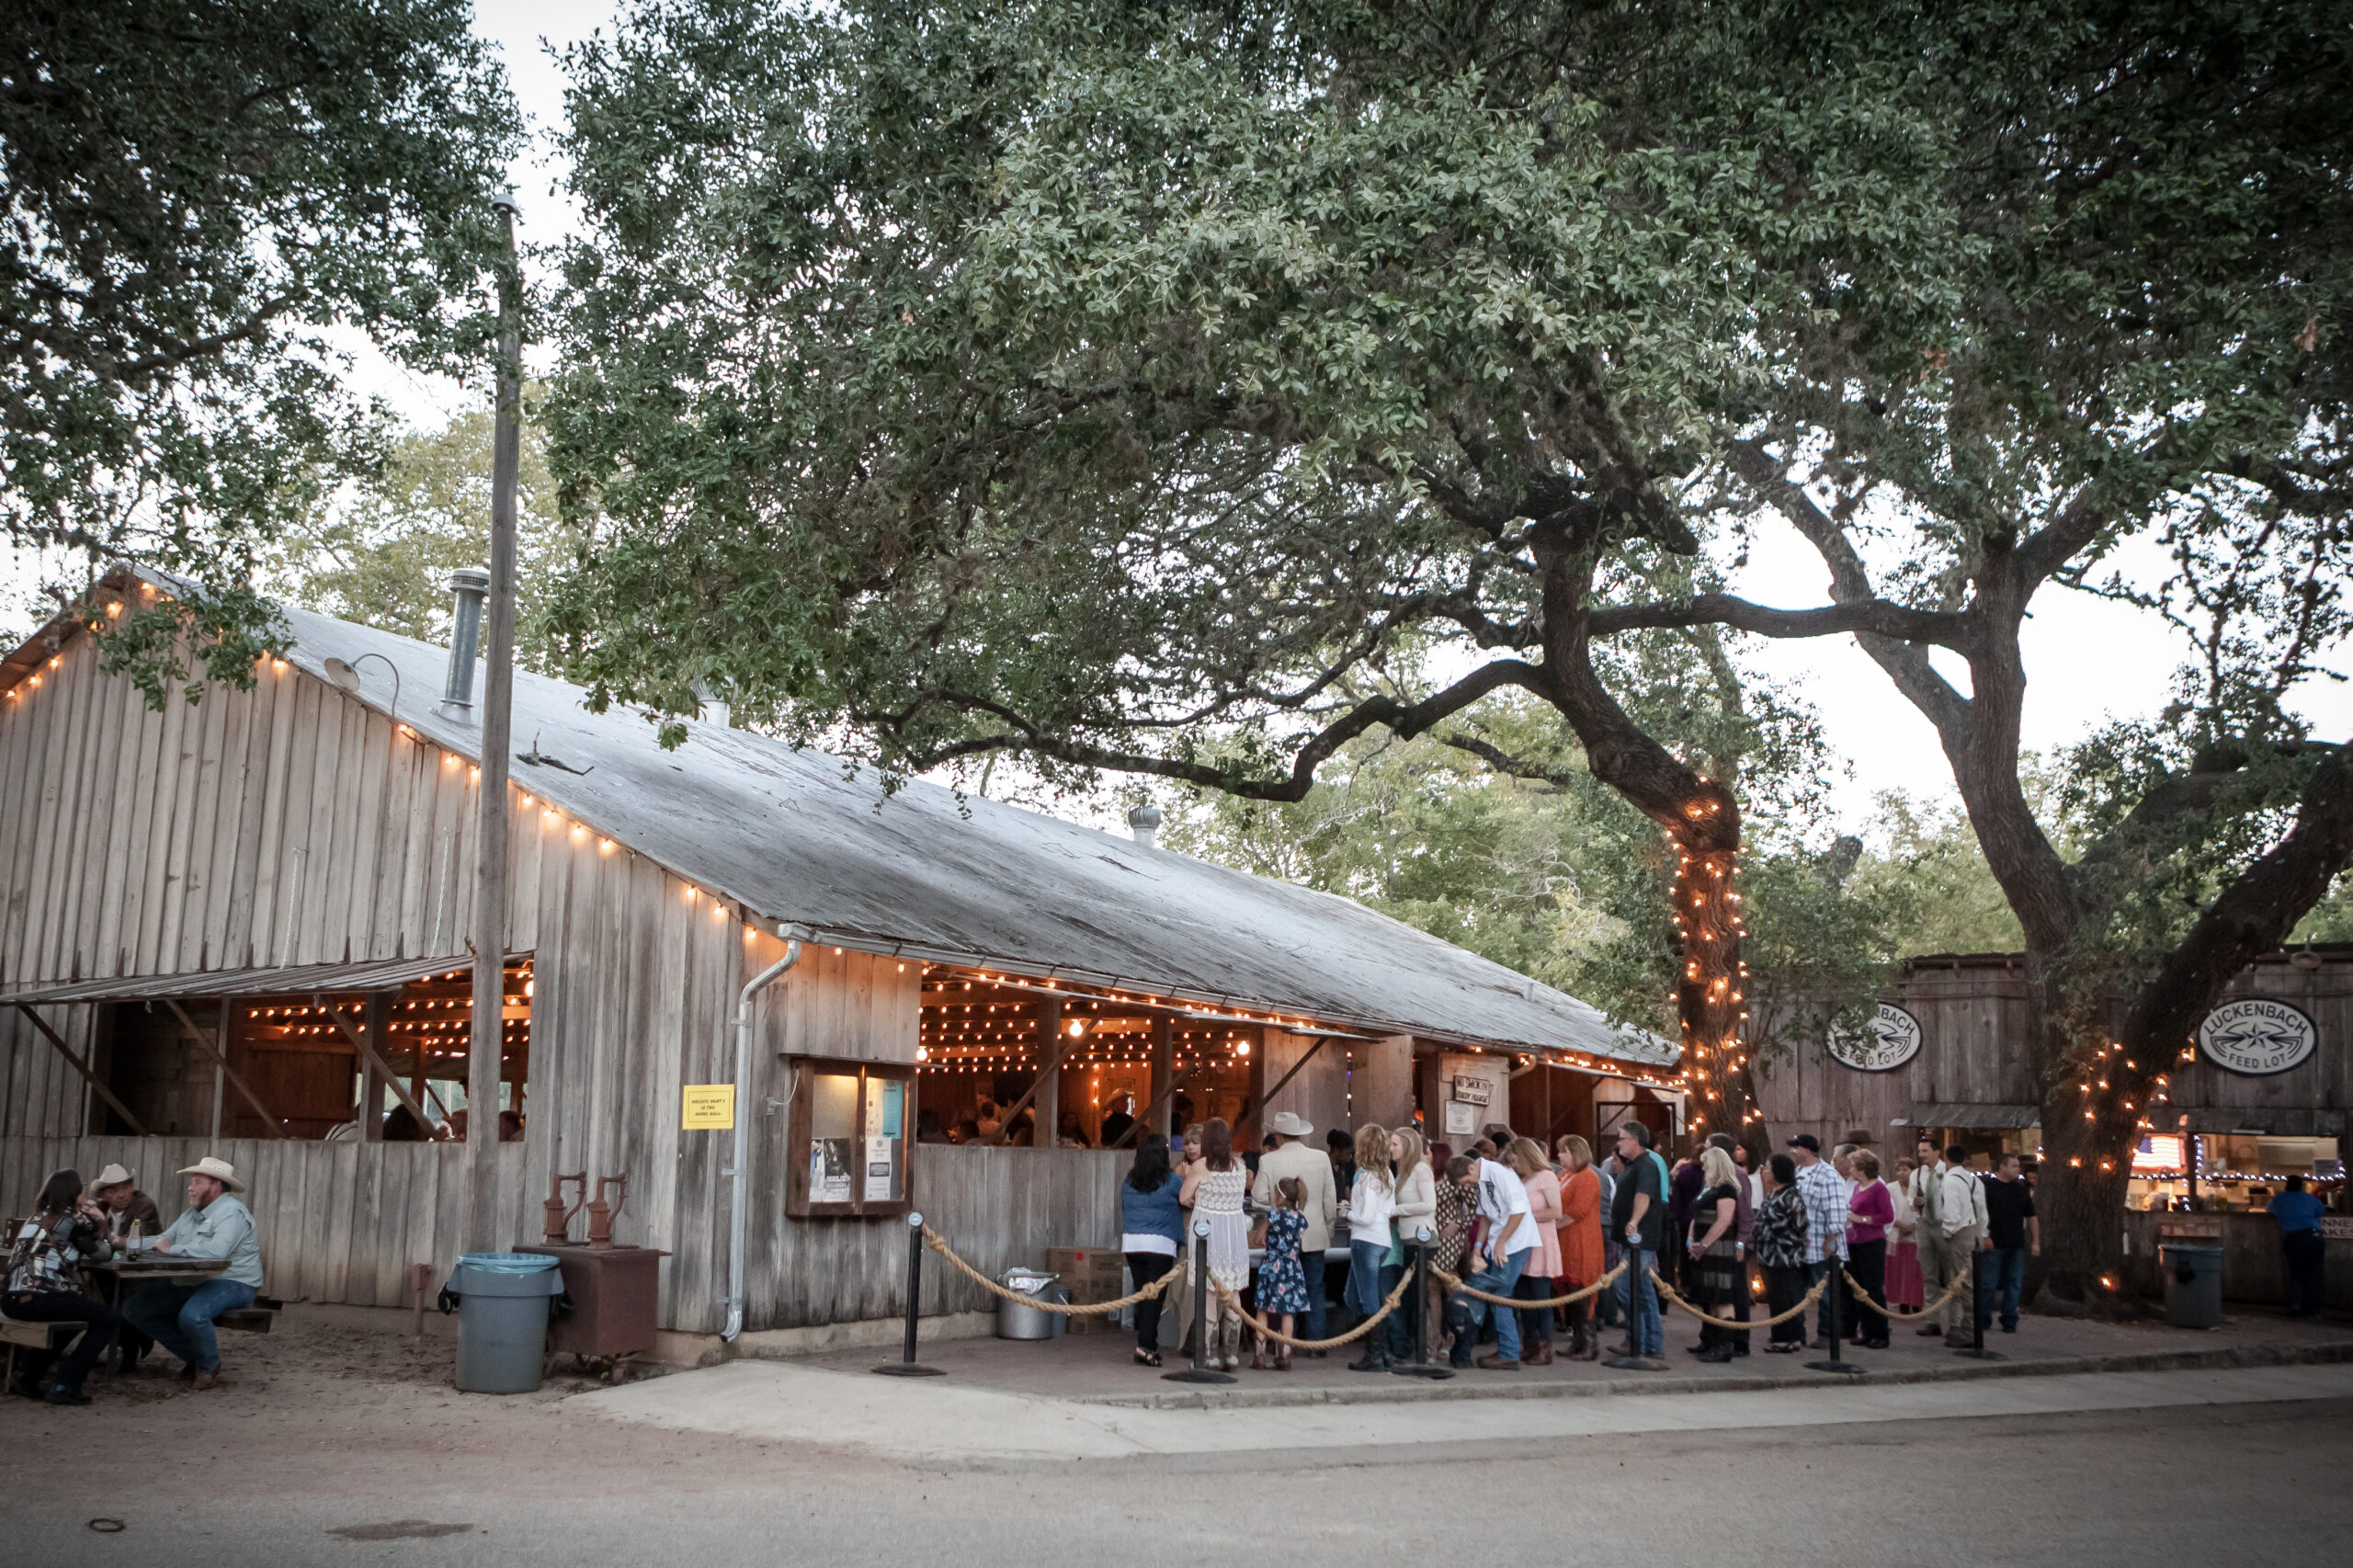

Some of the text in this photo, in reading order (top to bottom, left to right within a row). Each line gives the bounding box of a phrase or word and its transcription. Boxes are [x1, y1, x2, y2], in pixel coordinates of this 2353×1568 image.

[2204, 1003, 2308, 1035] LUCKENBACH
[2229, 1052, 2286, 1069] FEED LOT
